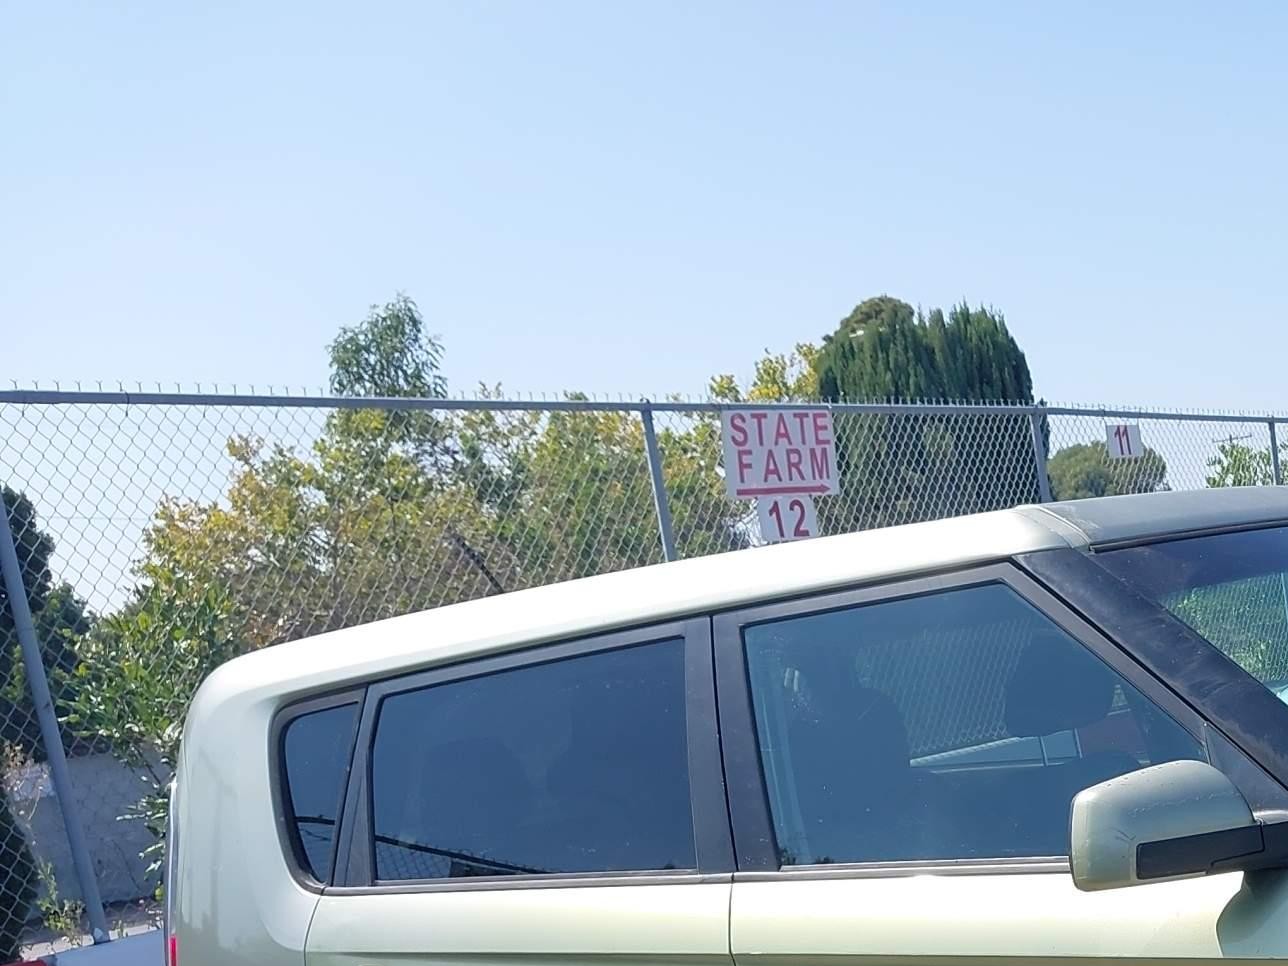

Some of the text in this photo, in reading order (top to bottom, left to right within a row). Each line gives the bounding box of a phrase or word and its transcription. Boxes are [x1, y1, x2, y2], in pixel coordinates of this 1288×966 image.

[730, 411, 831, 447] STATE
[1114, 424, 1132, 456] 11
[737, 448, 831, 484] FARM
[768, 498, 810, 539] 12
